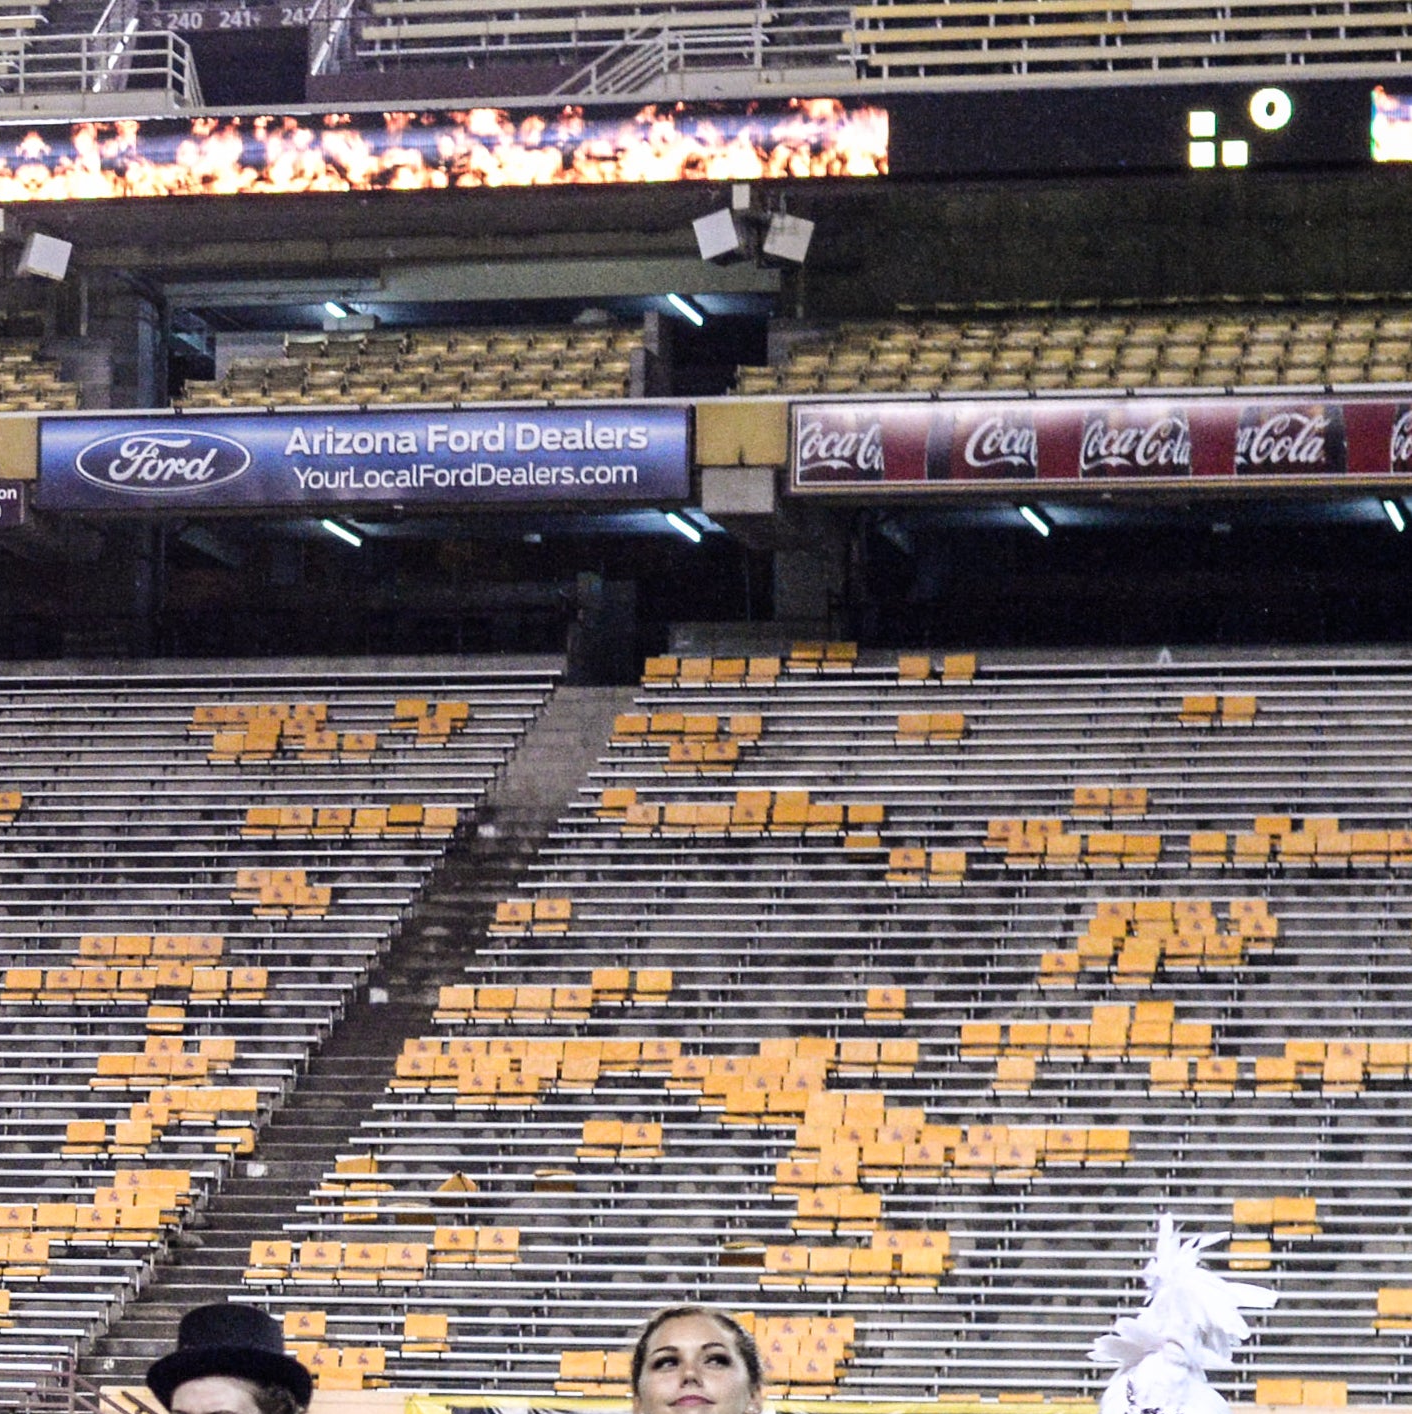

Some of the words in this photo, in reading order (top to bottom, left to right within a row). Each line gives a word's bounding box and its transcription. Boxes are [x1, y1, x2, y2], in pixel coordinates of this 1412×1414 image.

[167, 12, 203, 30] 240
[219, 11, 252, 28] 241
[284, 426, 418, 456] Arizona
[428, 422, 505, 453] Ford
[515, 420, 649, 450] Dealers
[108, 436, 218, 482] Ford
[292, 462, 638, 489] YourLocalFordDealers.com
